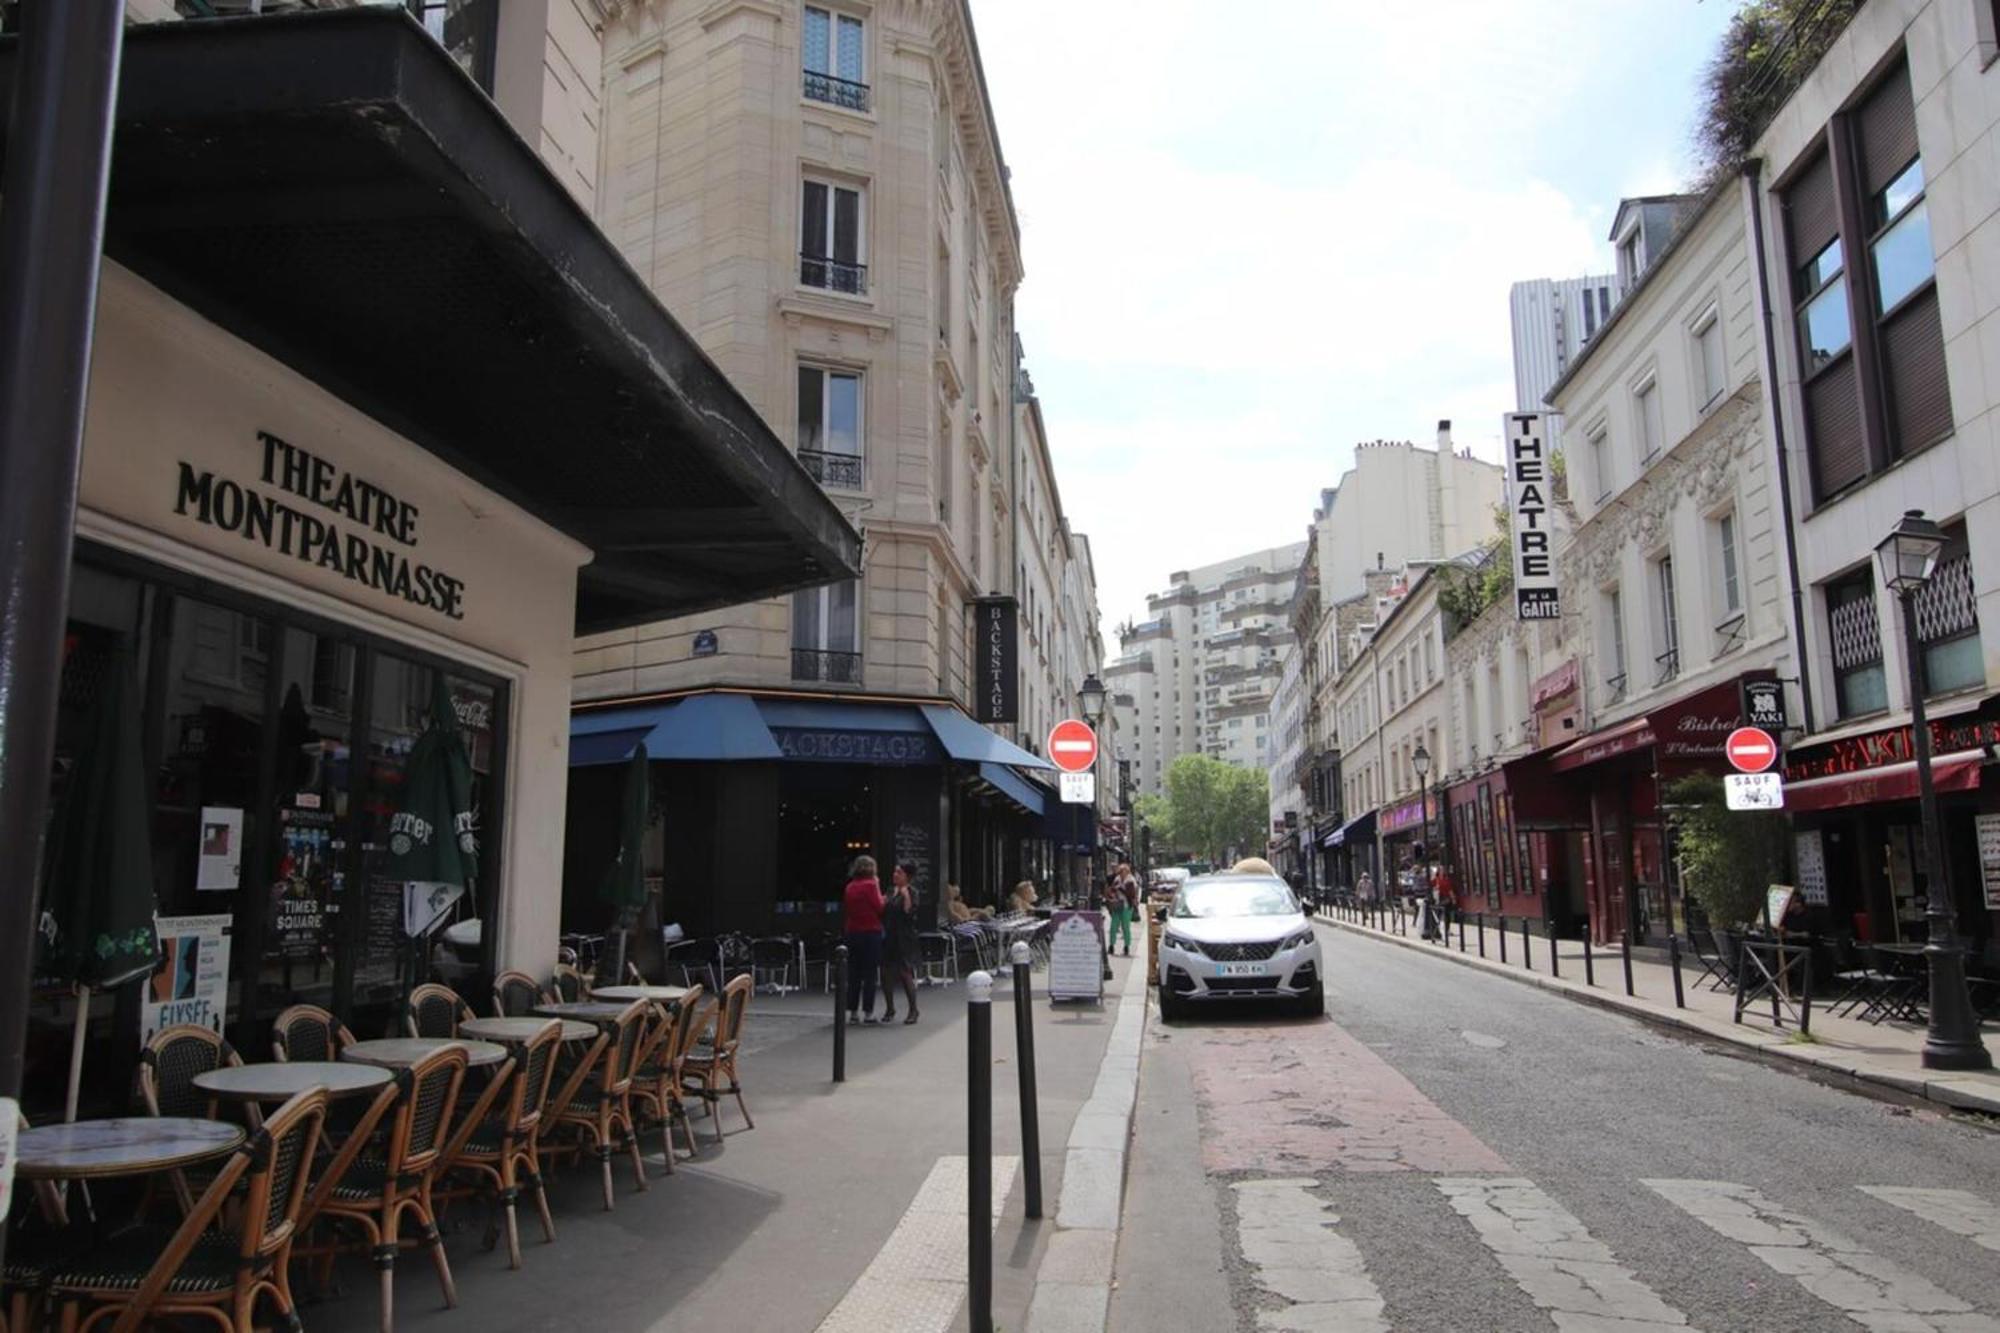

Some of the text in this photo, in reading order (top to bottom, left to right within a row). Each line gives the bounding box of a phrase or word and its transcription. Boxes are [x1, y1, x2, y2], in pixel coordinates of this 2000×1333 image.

[256, 430, 419, 547] THEATRE
[1512, 415, 1549, 577] THEATRE
[173, 461, 465, 621] MONTPARNASSE
[1520, 601, 1560, 618] GAITE
[991, 607, 1003, 719] BACKSTAGE
[1750, 713, 1783, 722] YAKI
[775, 733, 926, 759] ACKSTAGE
[1734, 776, 1770, 786] SAUF
[285, 900, 318, 914] TIMES
[276, 915, 322, 930] SQUARE
